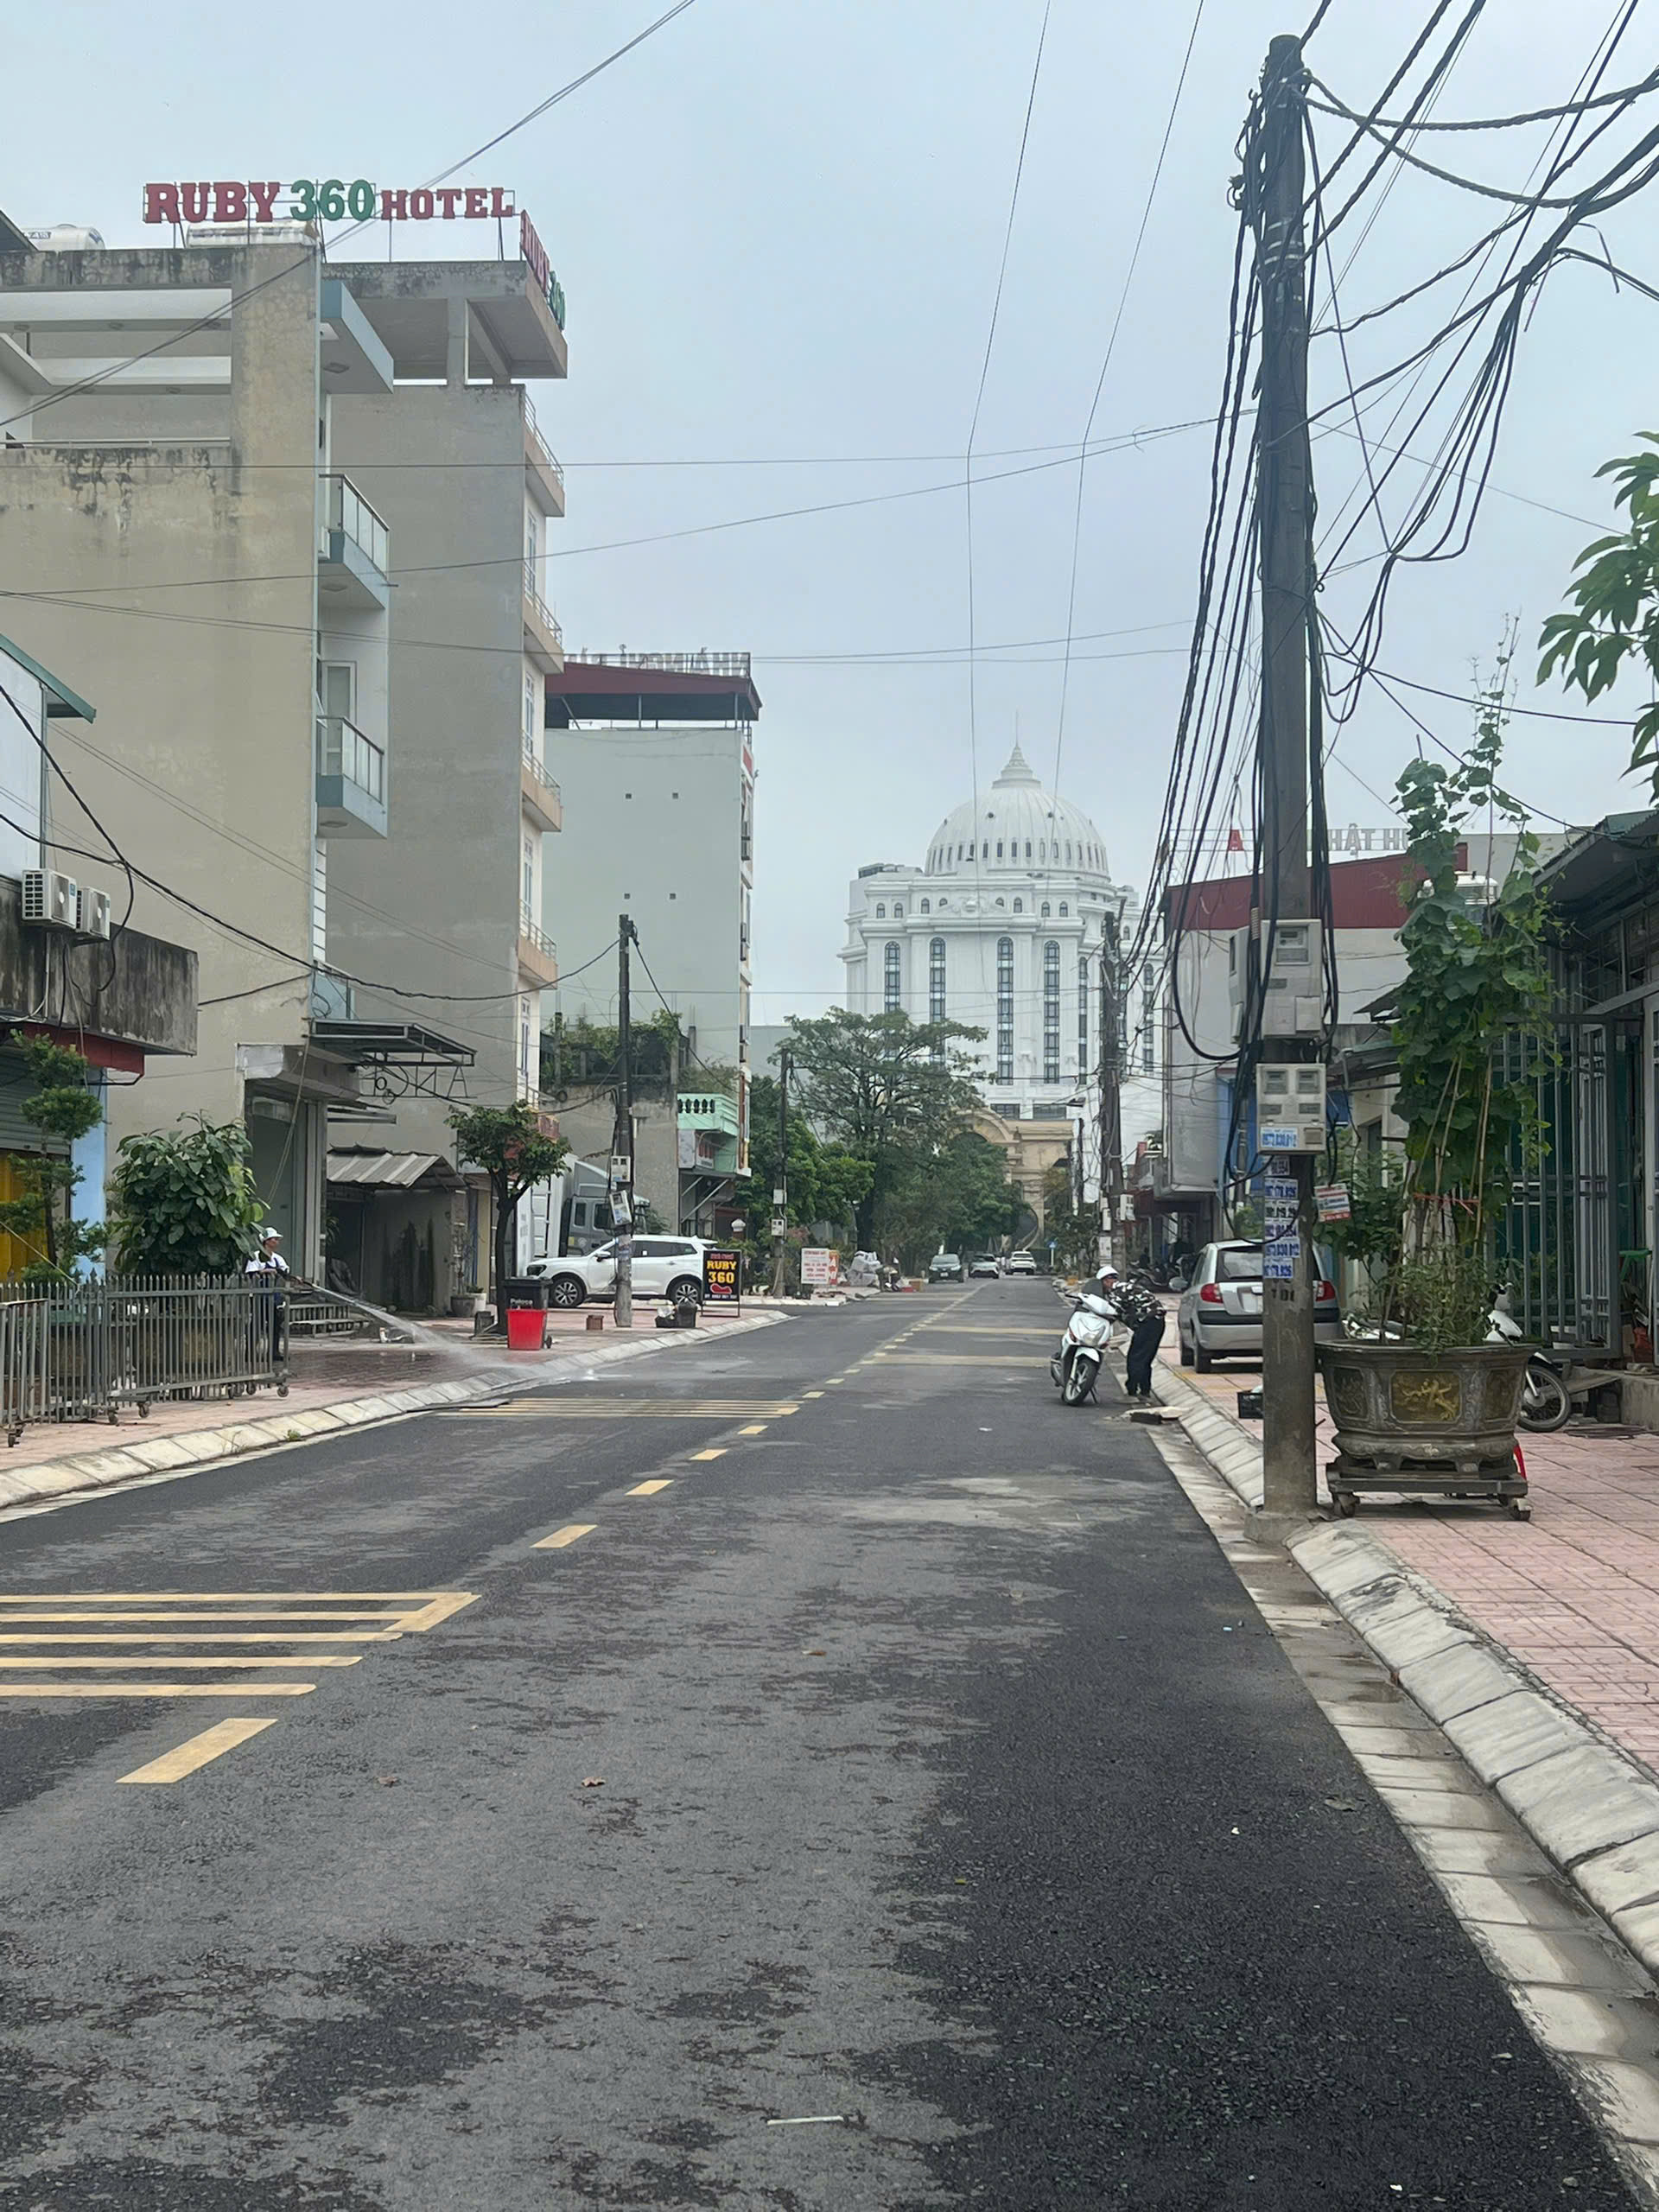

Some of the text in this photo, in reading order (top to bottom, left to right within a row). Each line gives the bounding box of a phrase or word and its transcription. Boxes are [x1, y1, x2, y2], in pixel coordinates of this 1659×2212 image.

[144, 179, 513, 224] RUBY 360 HOTEL
[1328, 823, 1376, 855] HẬT
[706, 1260, 737, 1270] RUBY
[708, 1271, 734, 1284] 360
